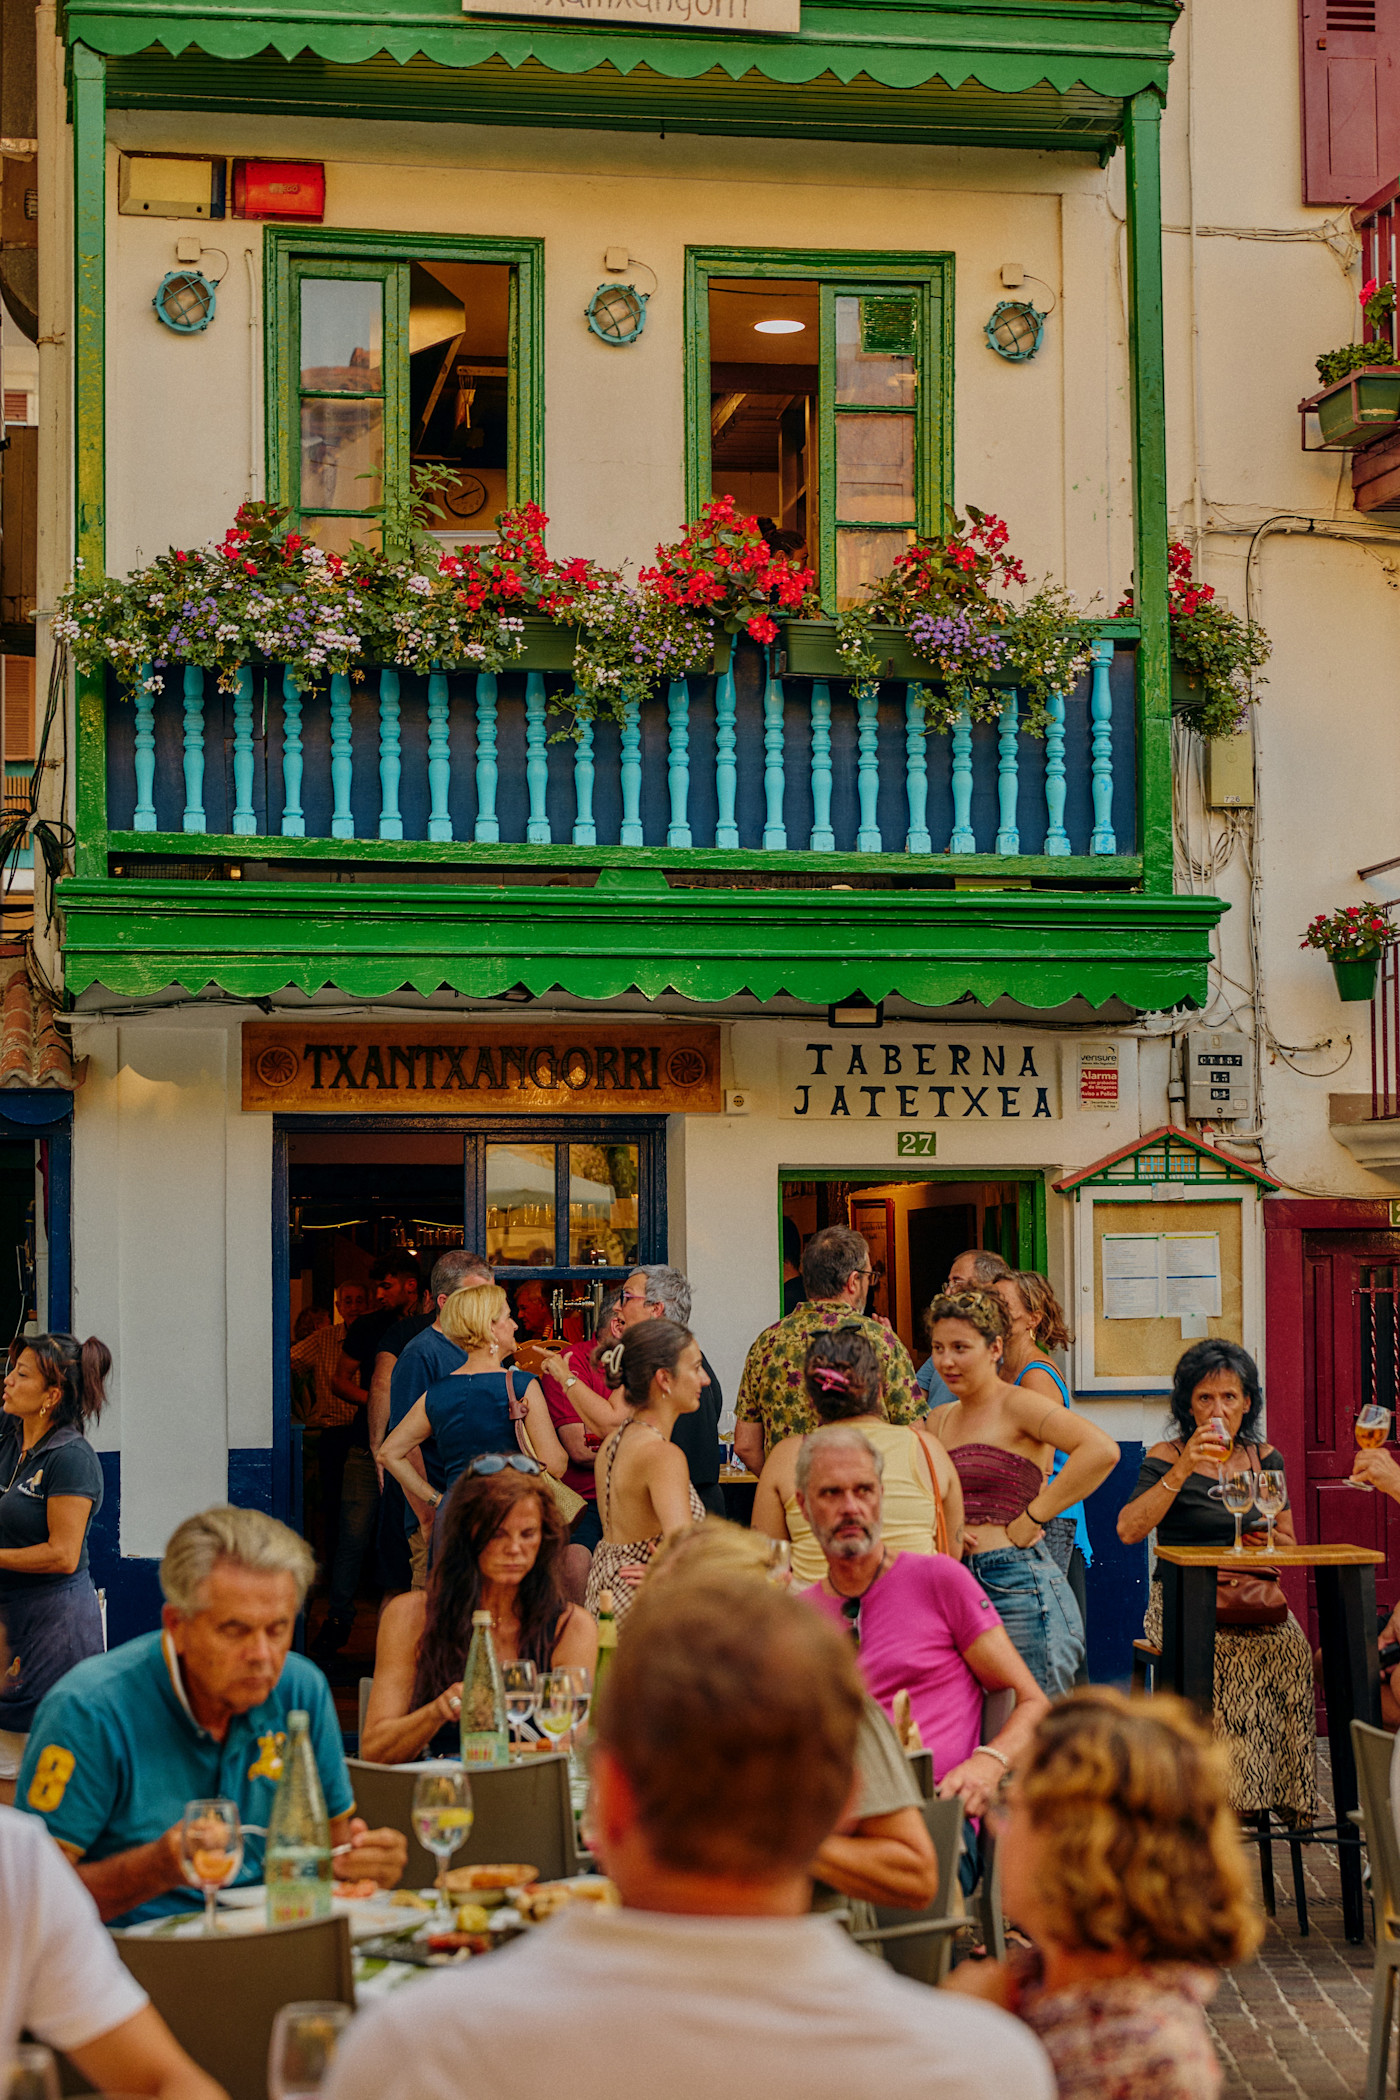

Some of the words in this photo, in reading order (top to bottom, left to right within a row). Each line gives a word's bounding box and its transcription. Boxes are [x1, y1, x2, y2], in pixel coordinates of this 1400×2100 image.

[303, 1045, 662, 1091] TXANTXANGORRI
[806, 1043, 1039, 1077] TABERNA
[1081, 1070, 1118, 1080] Alarma
[794, 1085, 1052, 1118] JATETXEA
[901, 1133, 933, 1154] 27
[28, 1744, 76, 1813] 8
